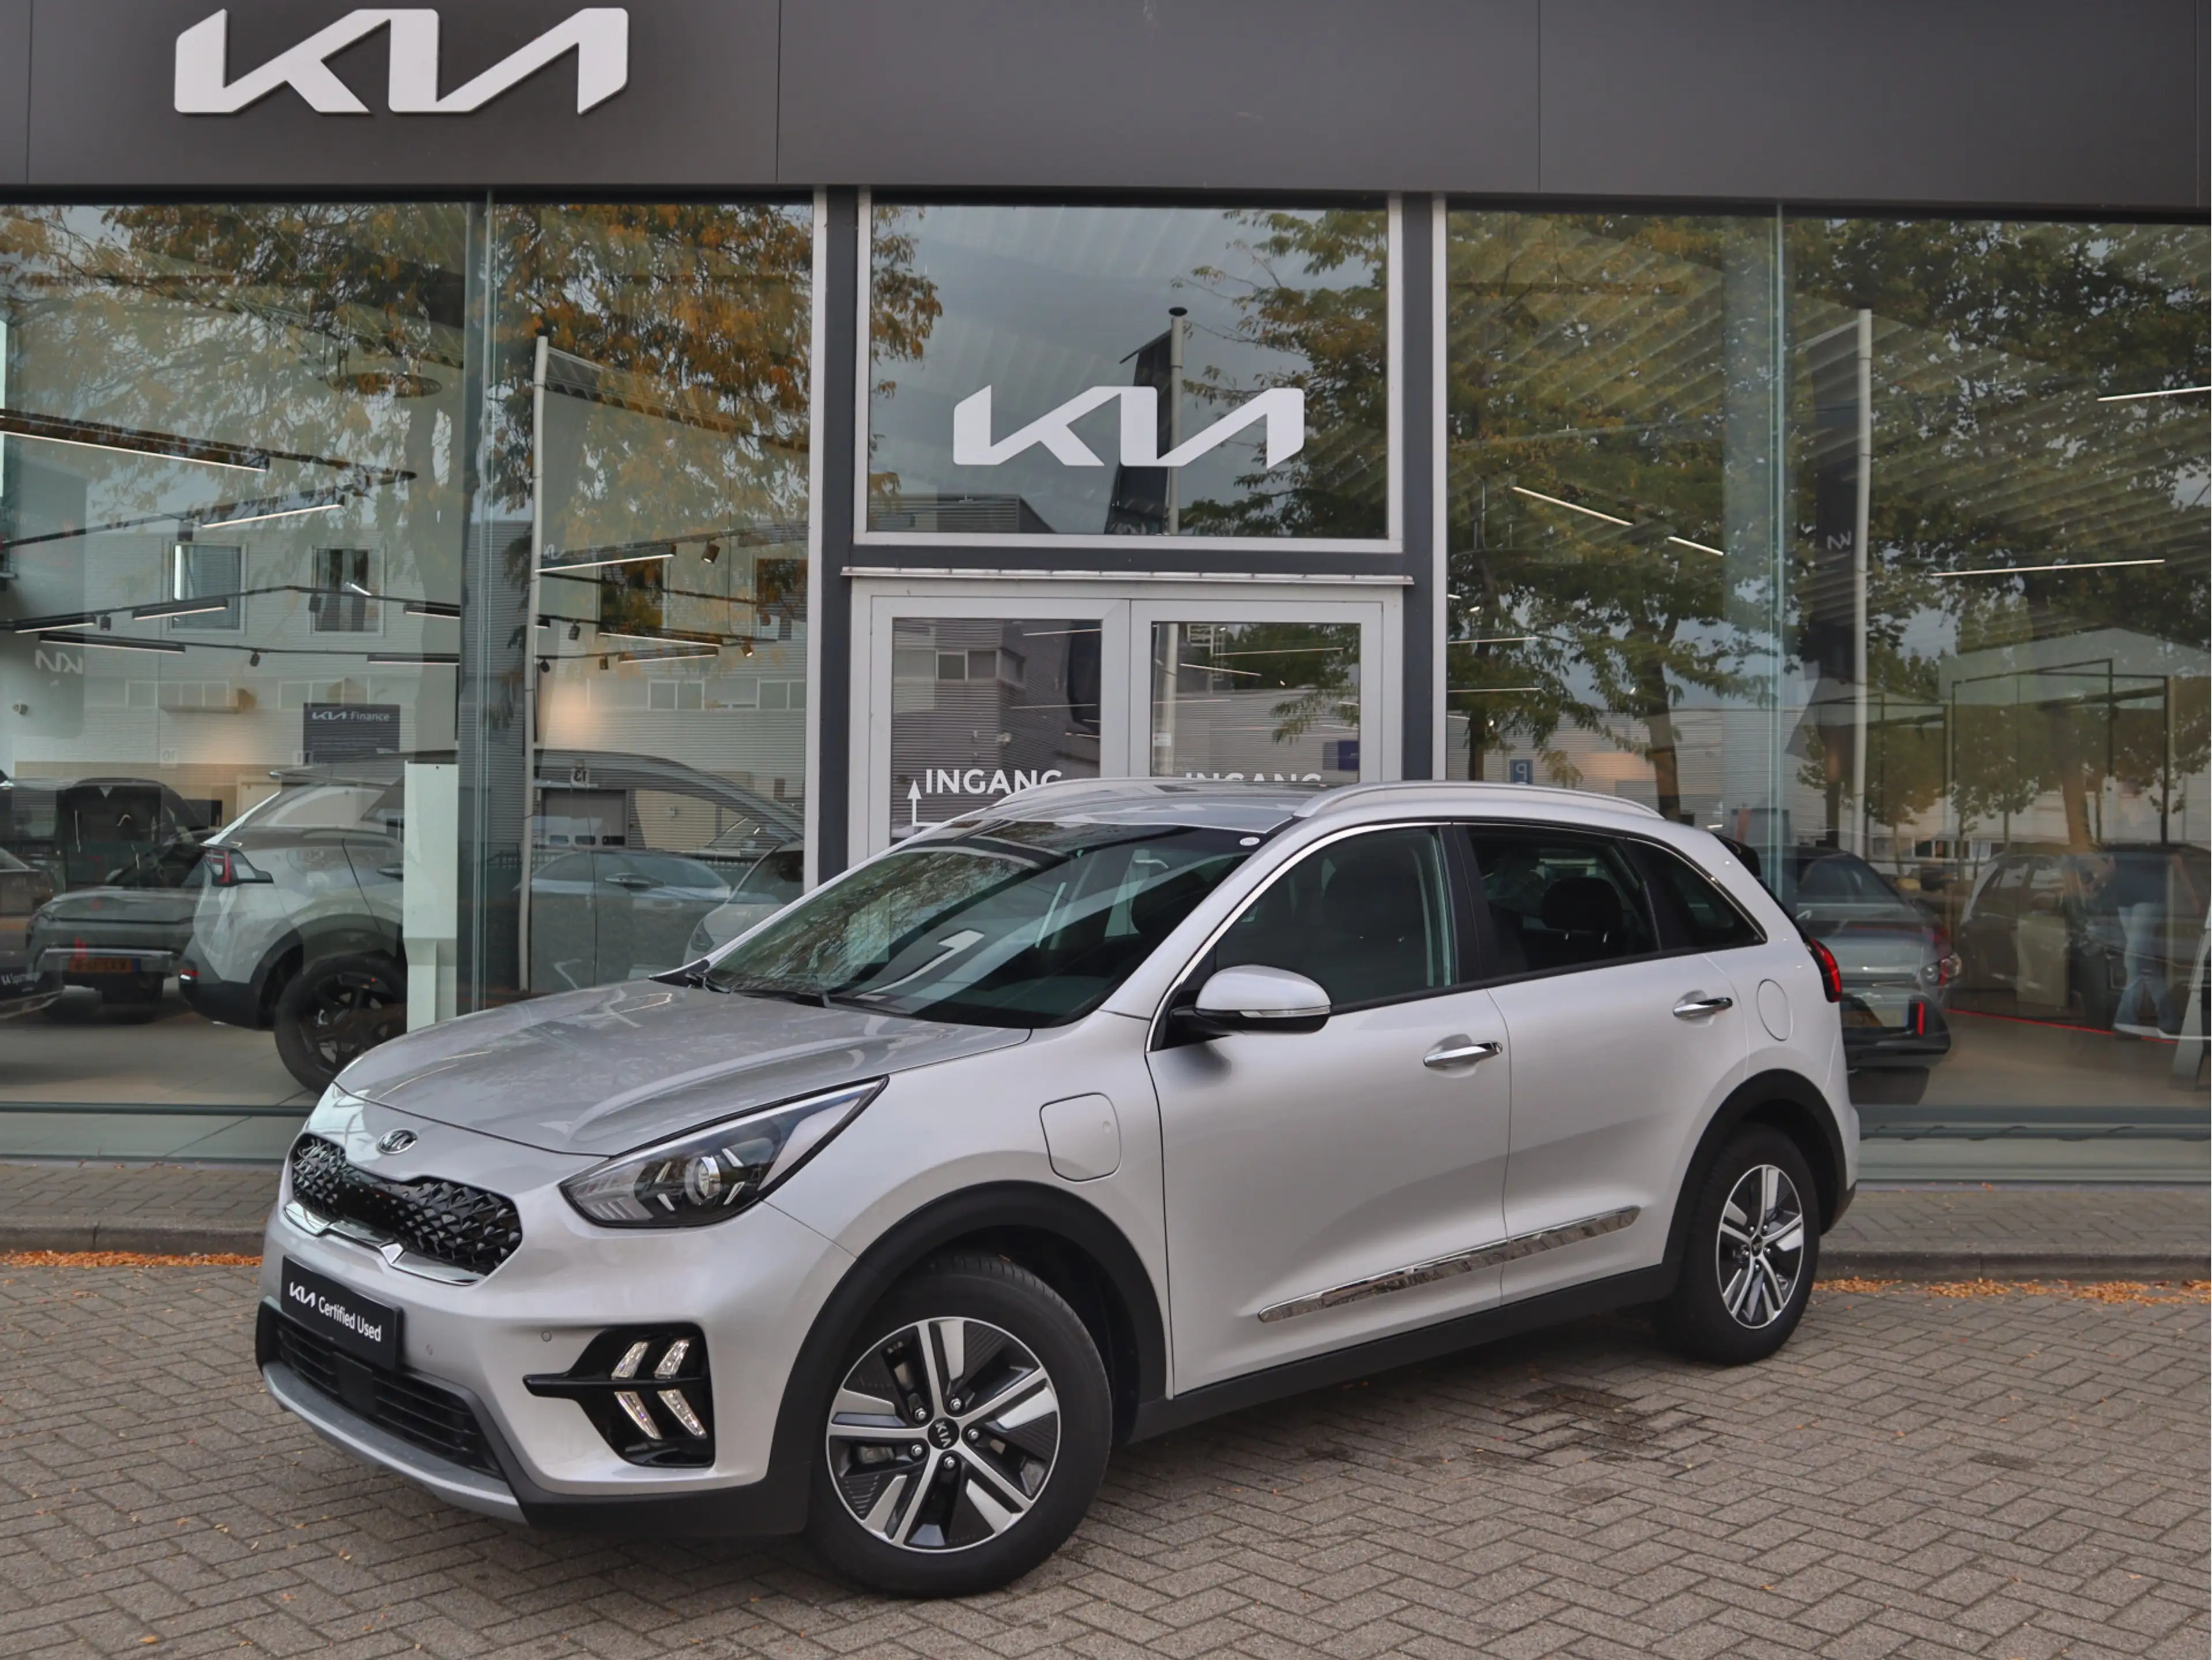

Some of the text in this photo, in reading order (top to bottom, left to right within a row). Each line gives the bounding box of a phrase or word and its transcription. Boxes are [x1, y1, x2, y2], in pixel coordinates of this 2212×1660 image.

[175, 7, 628, 114] KIA
[954, 384, 1305, 469] KIA
[312, 711, 390, 721] KIA Finance
[289, 1281, 382, 1342] KIA Certified Used
[935, 1421, 952, 1448] KIA
